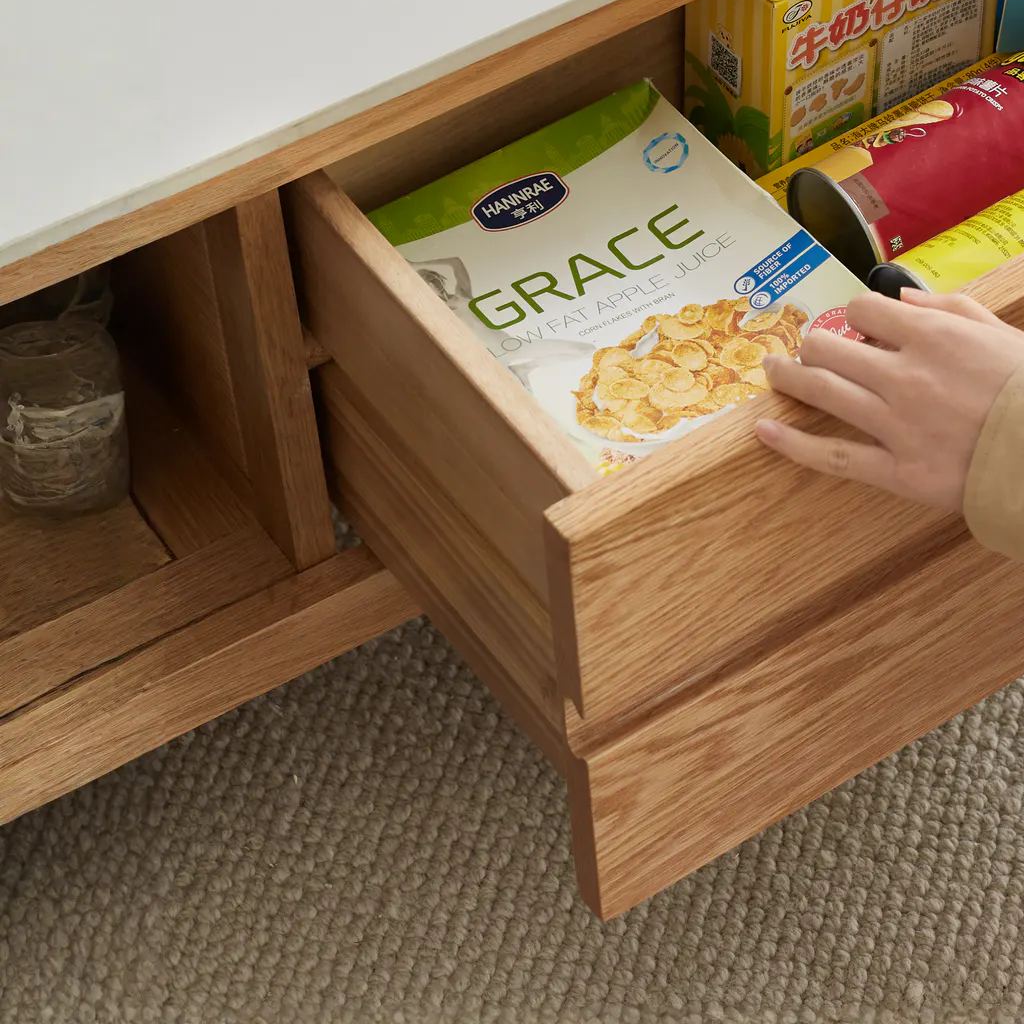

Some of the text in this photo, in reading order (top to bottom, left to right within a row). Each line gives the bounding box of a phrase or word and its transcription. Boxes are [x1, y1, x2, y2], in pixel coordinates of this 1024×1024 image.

[781, 14, 812, 34] FUJIYA
[985, 94, 1004, 111] CRISPS
[654, 142, 679, 164] INNOVATION
[481, 178, 553, 218] HANNRAE
[468, 204, 705, 330] GRACE
[753, 242, 792, 275] SOURCE OF
[758, 260, 781, 280] FIBER
[769, 273, 790, 289] 100%
[773, 264, 811, 295] IMPORTED
[487, 232, 737, 359] LOW FAT APPLE JUICE
[578, 292, 675, 337] CORN FLAKES WITH BRAN
